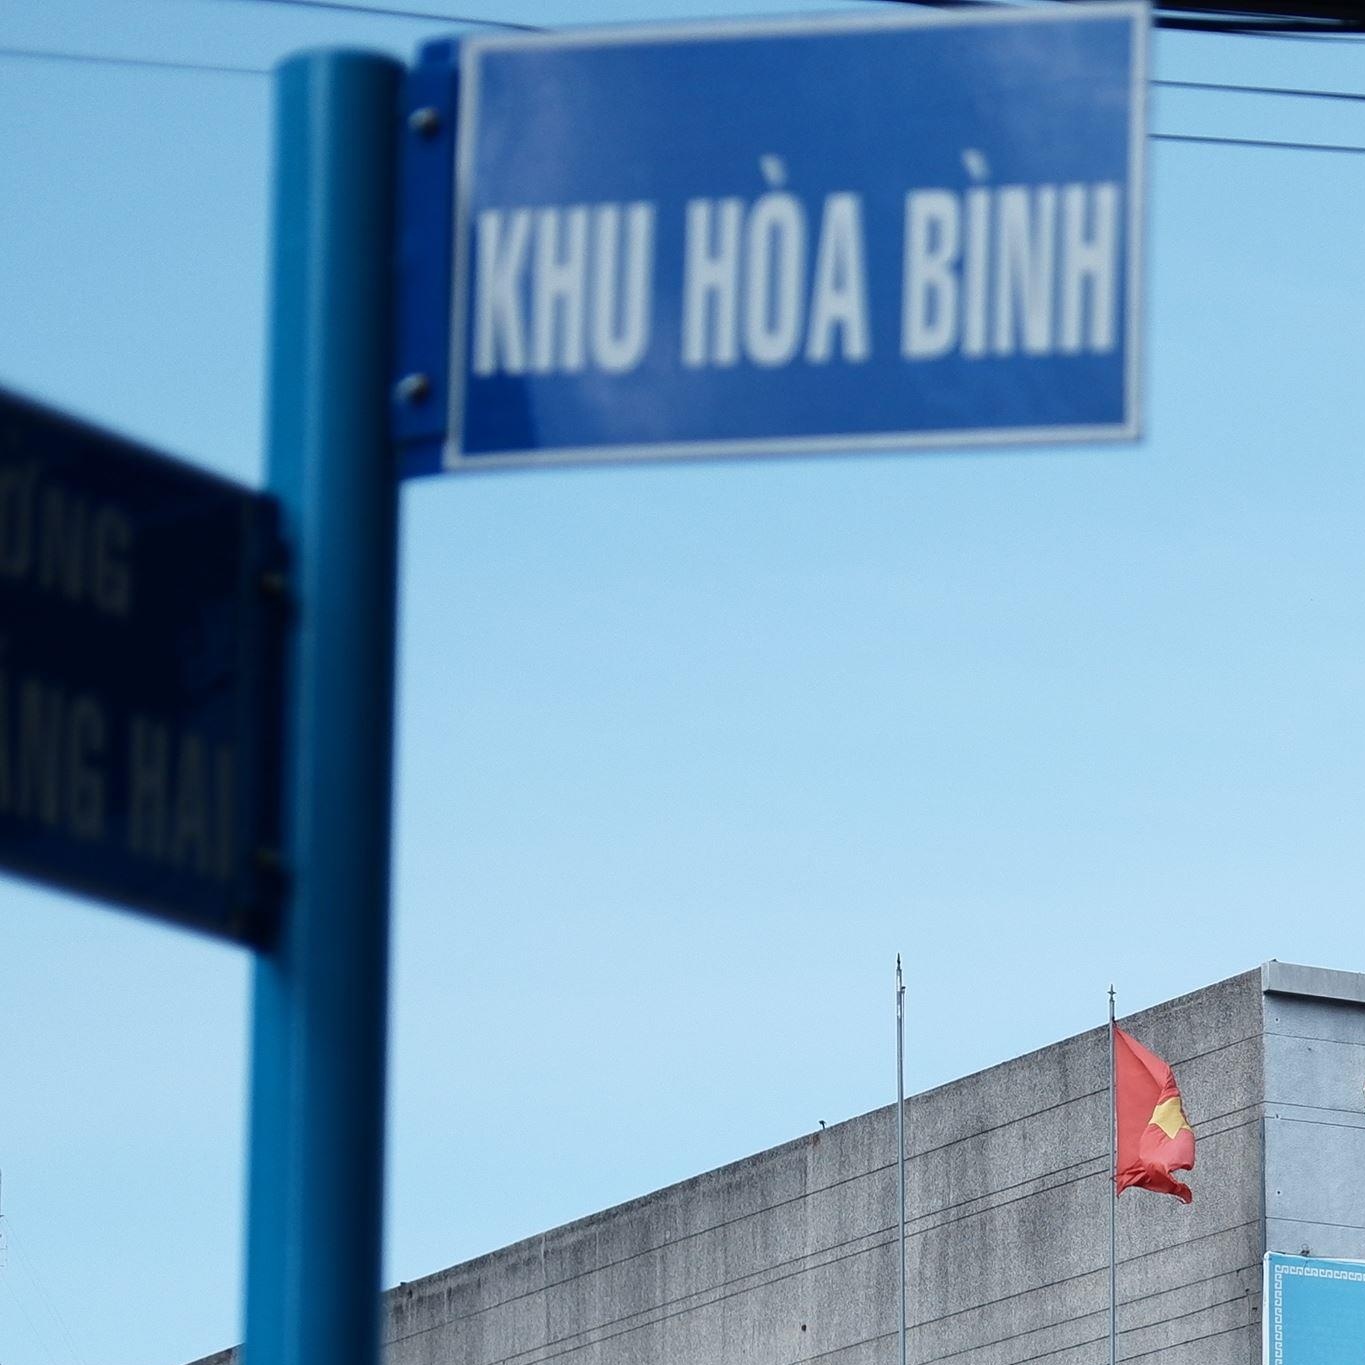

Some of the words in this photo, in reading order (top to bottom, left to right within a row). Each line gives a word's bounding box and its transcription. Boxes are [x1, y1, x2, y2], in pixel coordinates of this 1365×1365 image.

[472, 200, 653, 377] KHU
[682, 153, 870, 367] HÒA
[902, 148, 1120, 361] BÌNH
